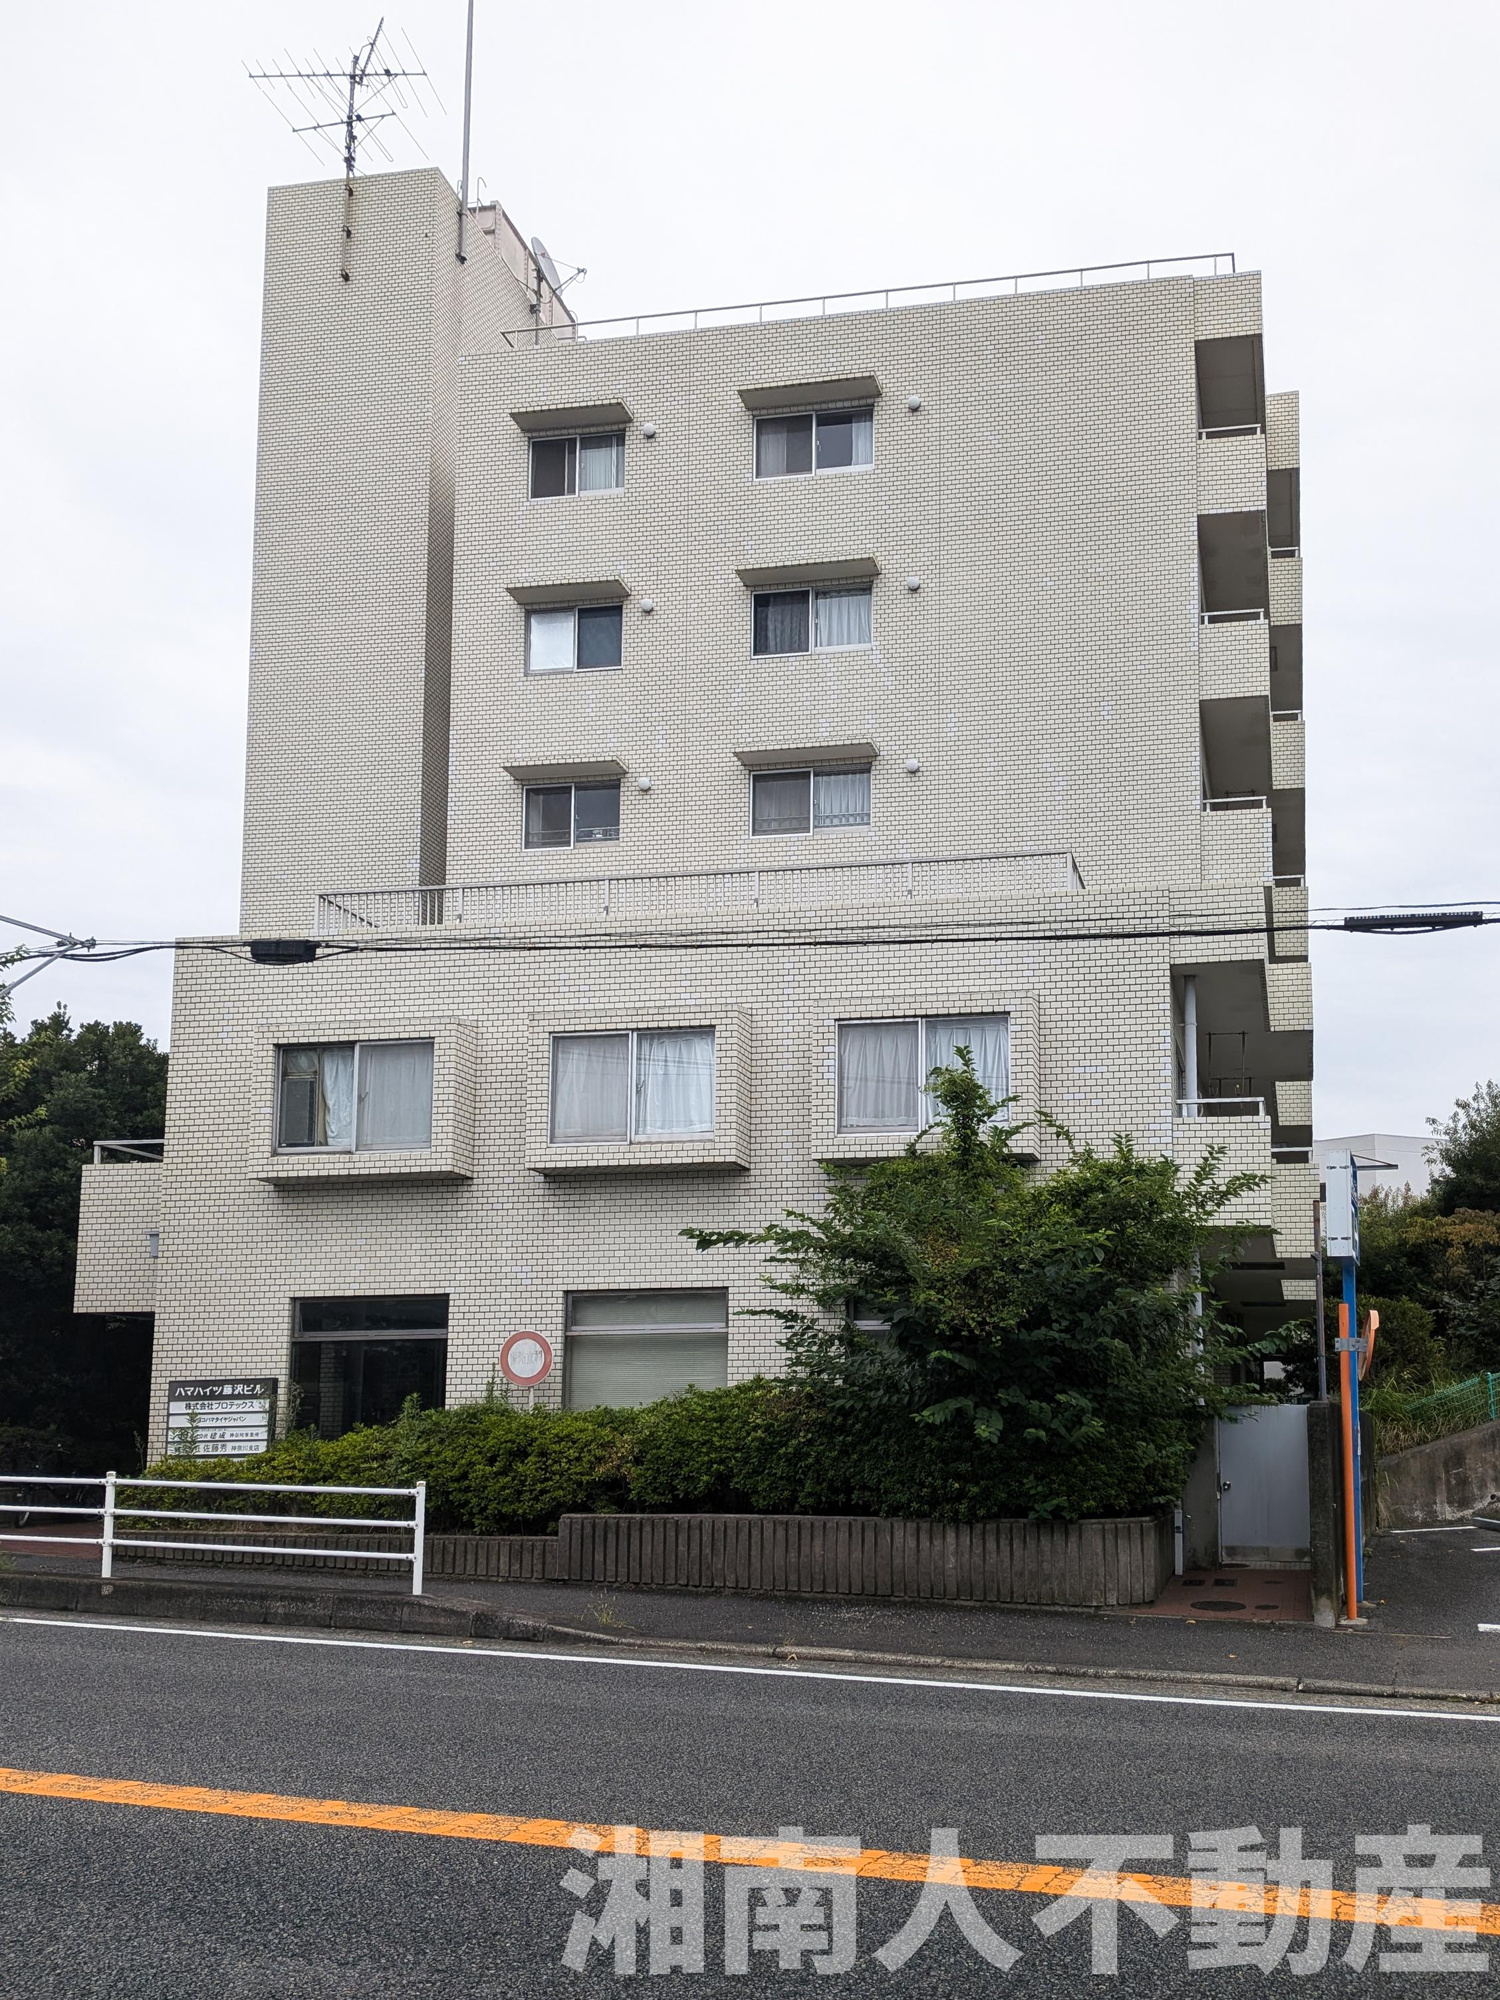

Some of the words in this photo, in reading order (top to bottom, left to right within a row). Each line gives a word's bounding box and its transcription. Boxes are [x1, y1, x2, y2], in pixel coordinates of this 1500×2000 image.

[175, 1384, 264, 1397] ハマハイツ藤沢ビル
[184, 1401, 255, 1410] 株式会社プロテックス
